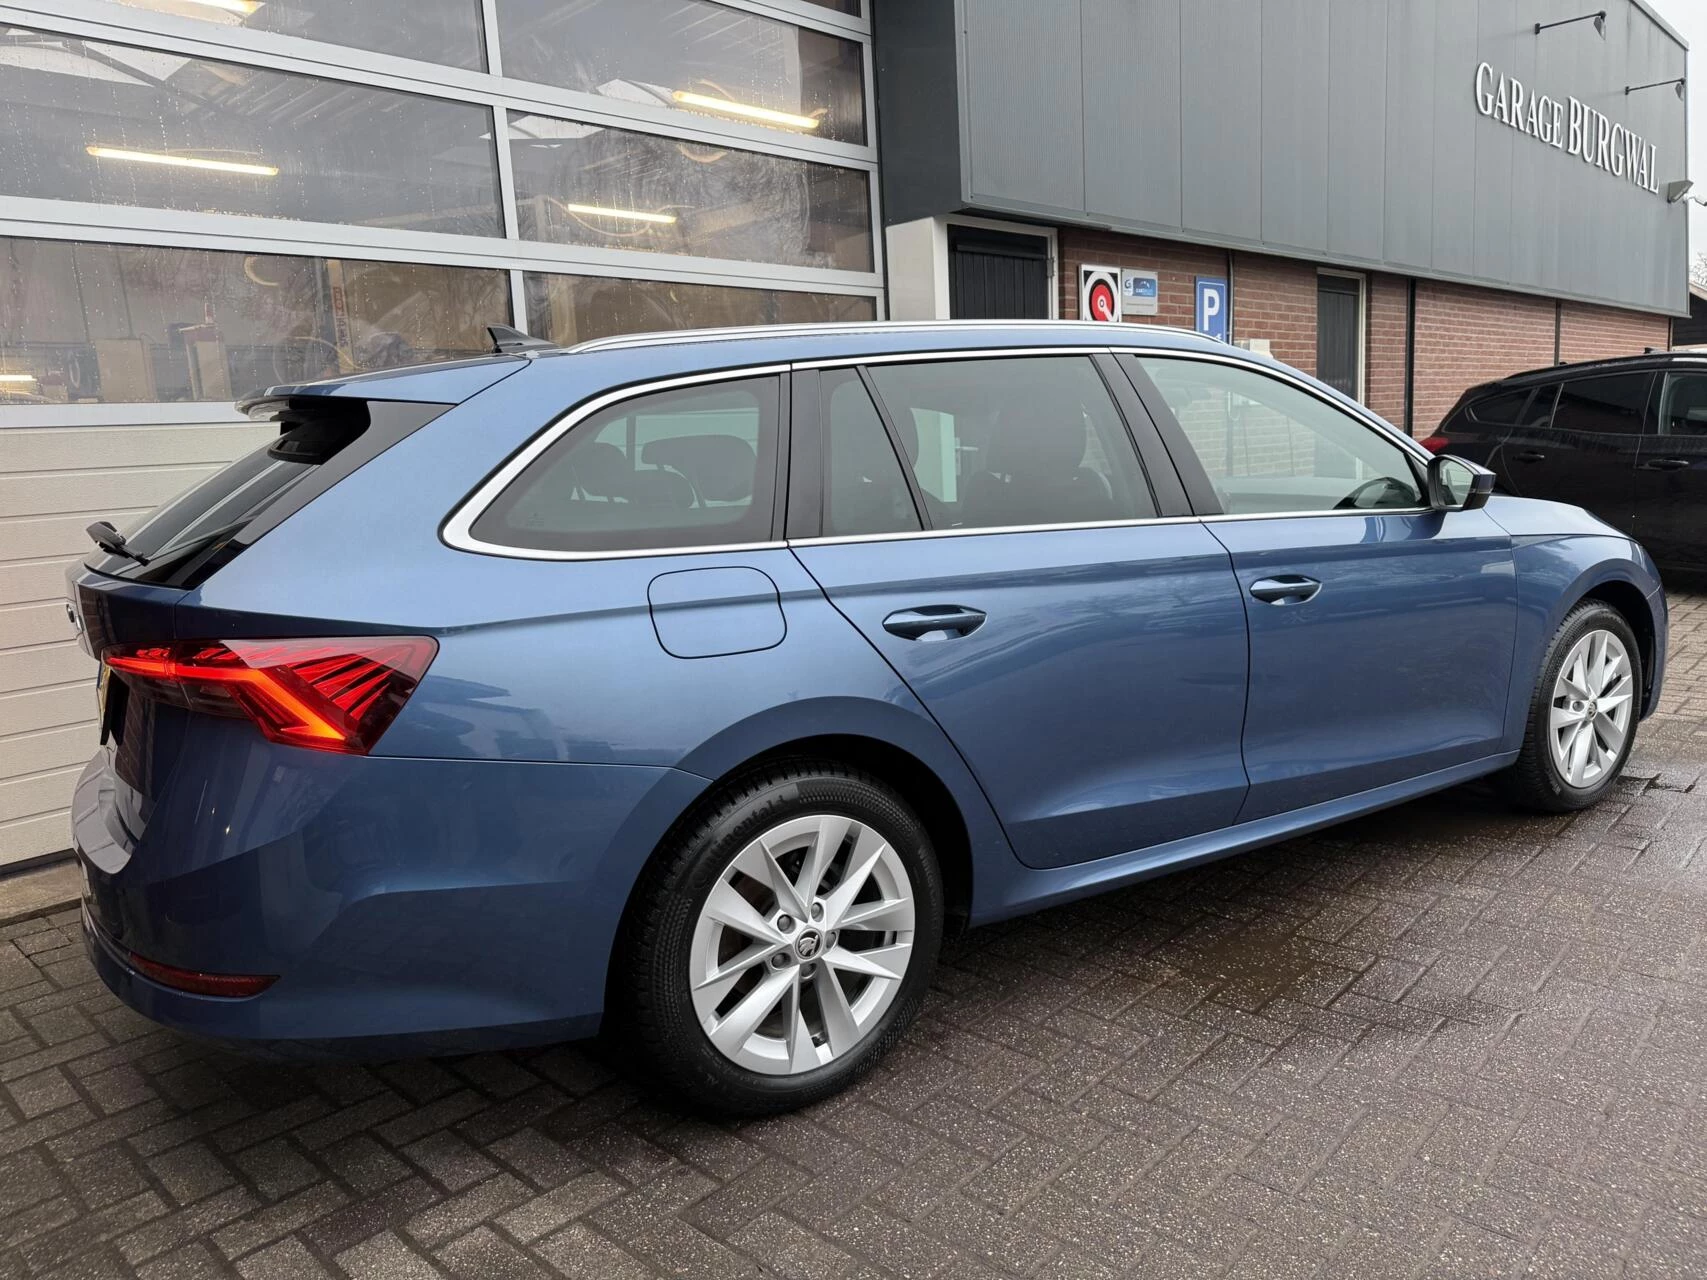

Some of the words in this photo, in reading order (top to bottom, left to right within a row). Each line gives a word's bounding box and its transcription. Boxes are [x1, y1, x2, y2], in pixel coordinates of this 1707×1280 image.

[1475, 61, 1564, 149] GARAGE
[1567, 95, 1660, 194] BURGWAL
[1203, 288, 1220, 331] P
